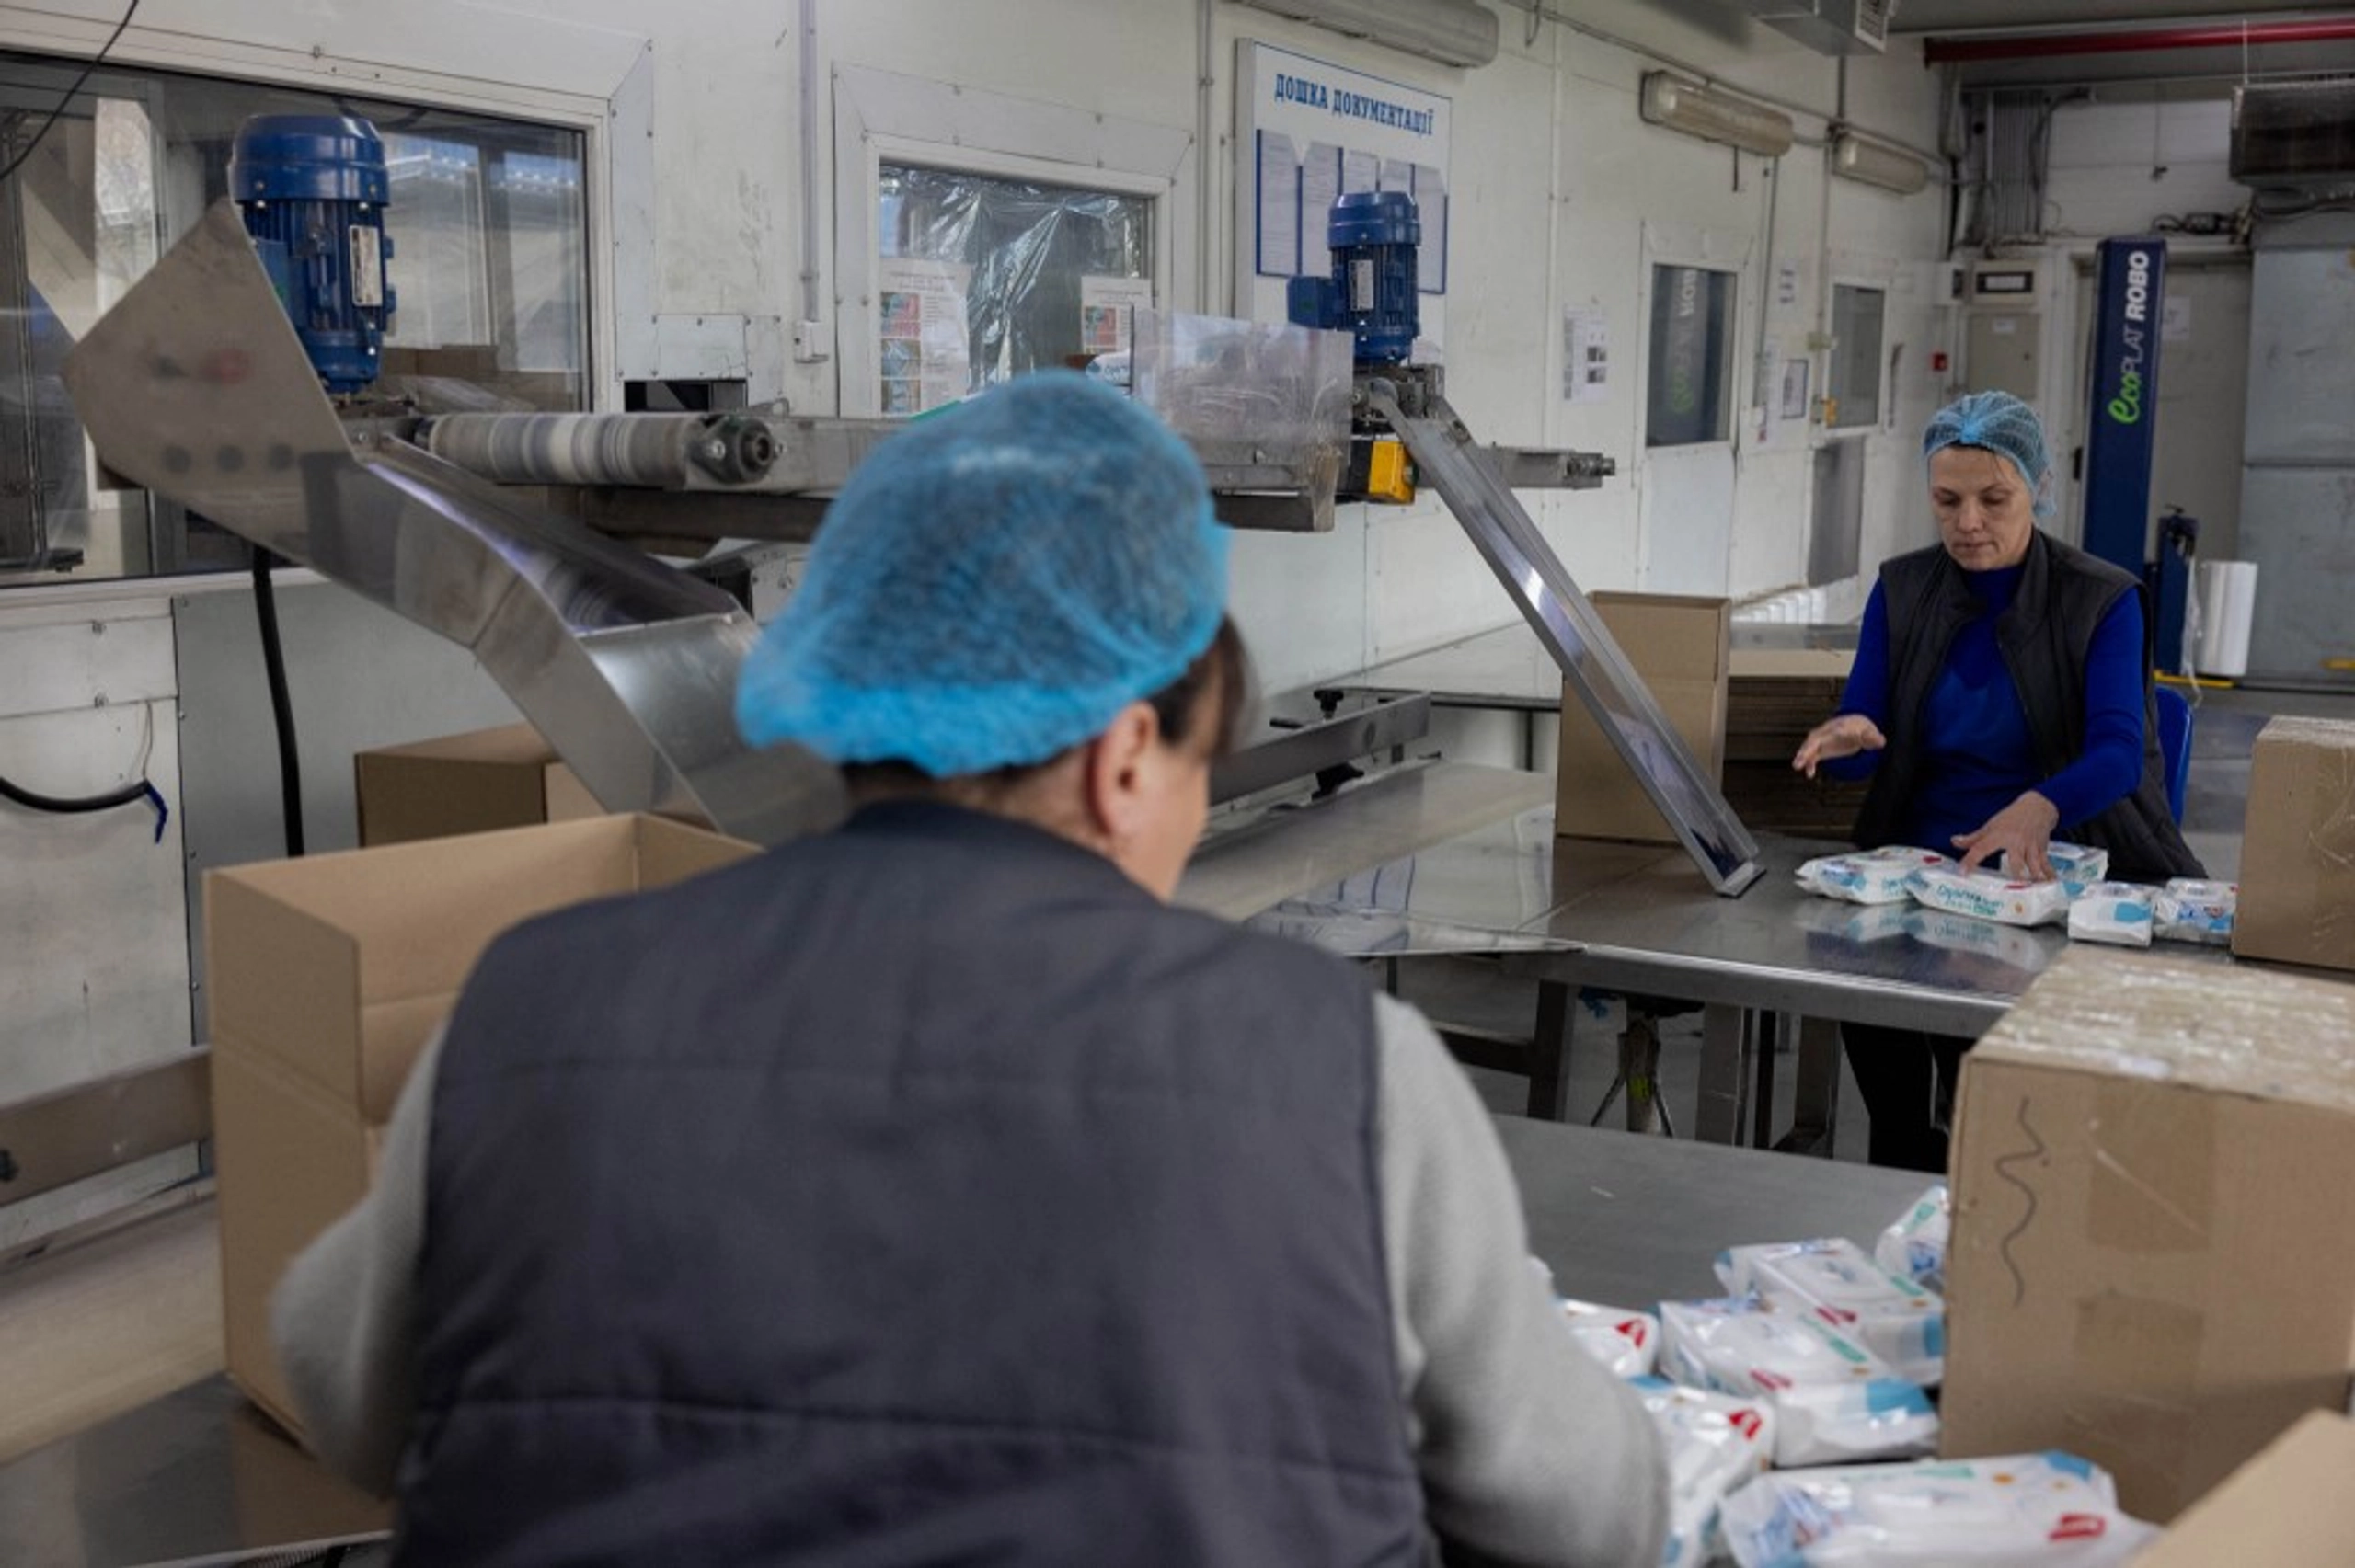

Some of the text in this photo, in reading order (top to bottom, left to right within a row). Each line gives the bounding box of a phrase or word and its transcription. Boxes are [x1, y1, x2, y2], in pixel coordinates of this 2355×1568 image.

[1275, 74, 1434, 137] ДОШКА ДОКУМЕНТАЦІЇ
[2125, 250, 2150, 321] ROBO
